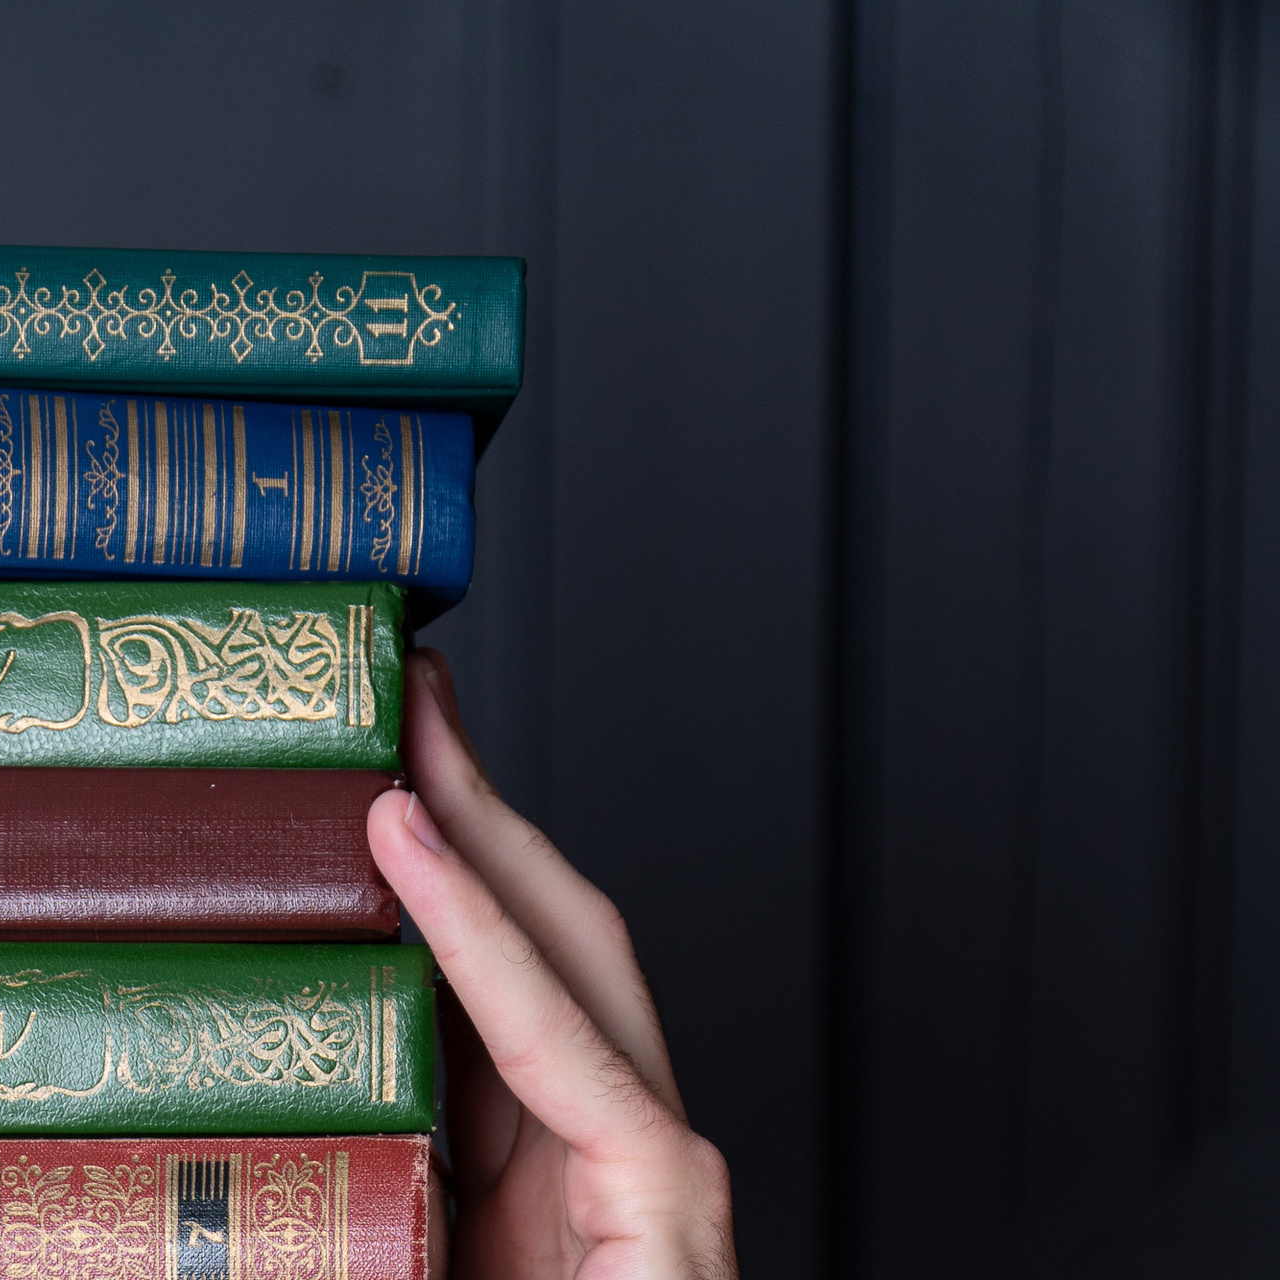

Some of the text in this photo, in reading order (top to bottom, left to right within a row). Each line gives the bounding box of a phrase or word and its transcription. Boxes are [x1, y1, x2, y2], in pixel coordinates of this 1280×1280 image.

[364, 292, 409, 340] 11
[252, 470, 289, 498] 1
[181, 1220, 225, 1248] 7
